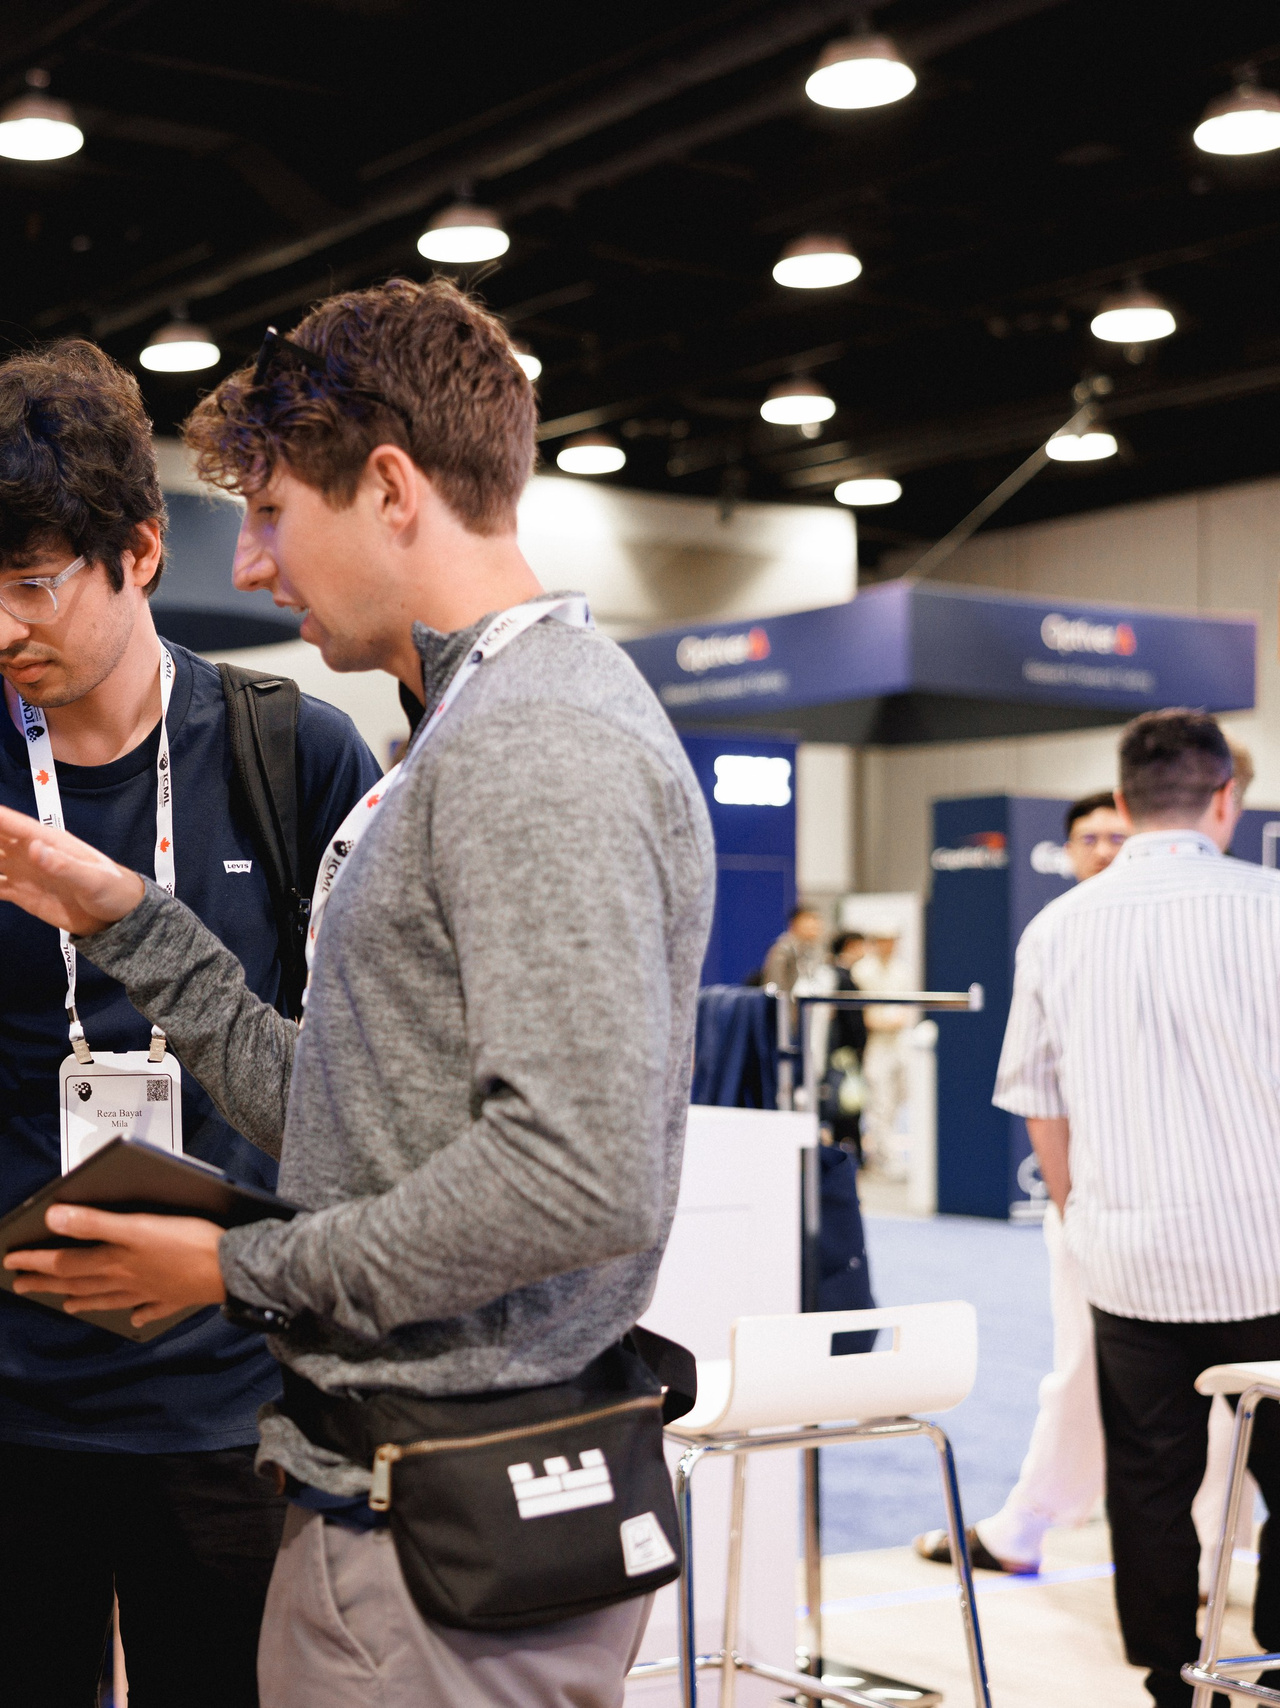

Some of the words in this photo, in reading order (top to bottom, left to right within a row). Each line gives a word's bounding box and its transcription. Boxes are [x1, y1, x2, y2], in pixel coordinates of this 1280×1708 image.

[482, 617, 515, 646] ICML
[22, 698, 35, 725] ICM
[321, 858, 342, 894] ICML
[97, 1109, 117, 1118] Reza
[119, 1109, 142, 1119] Bayat
